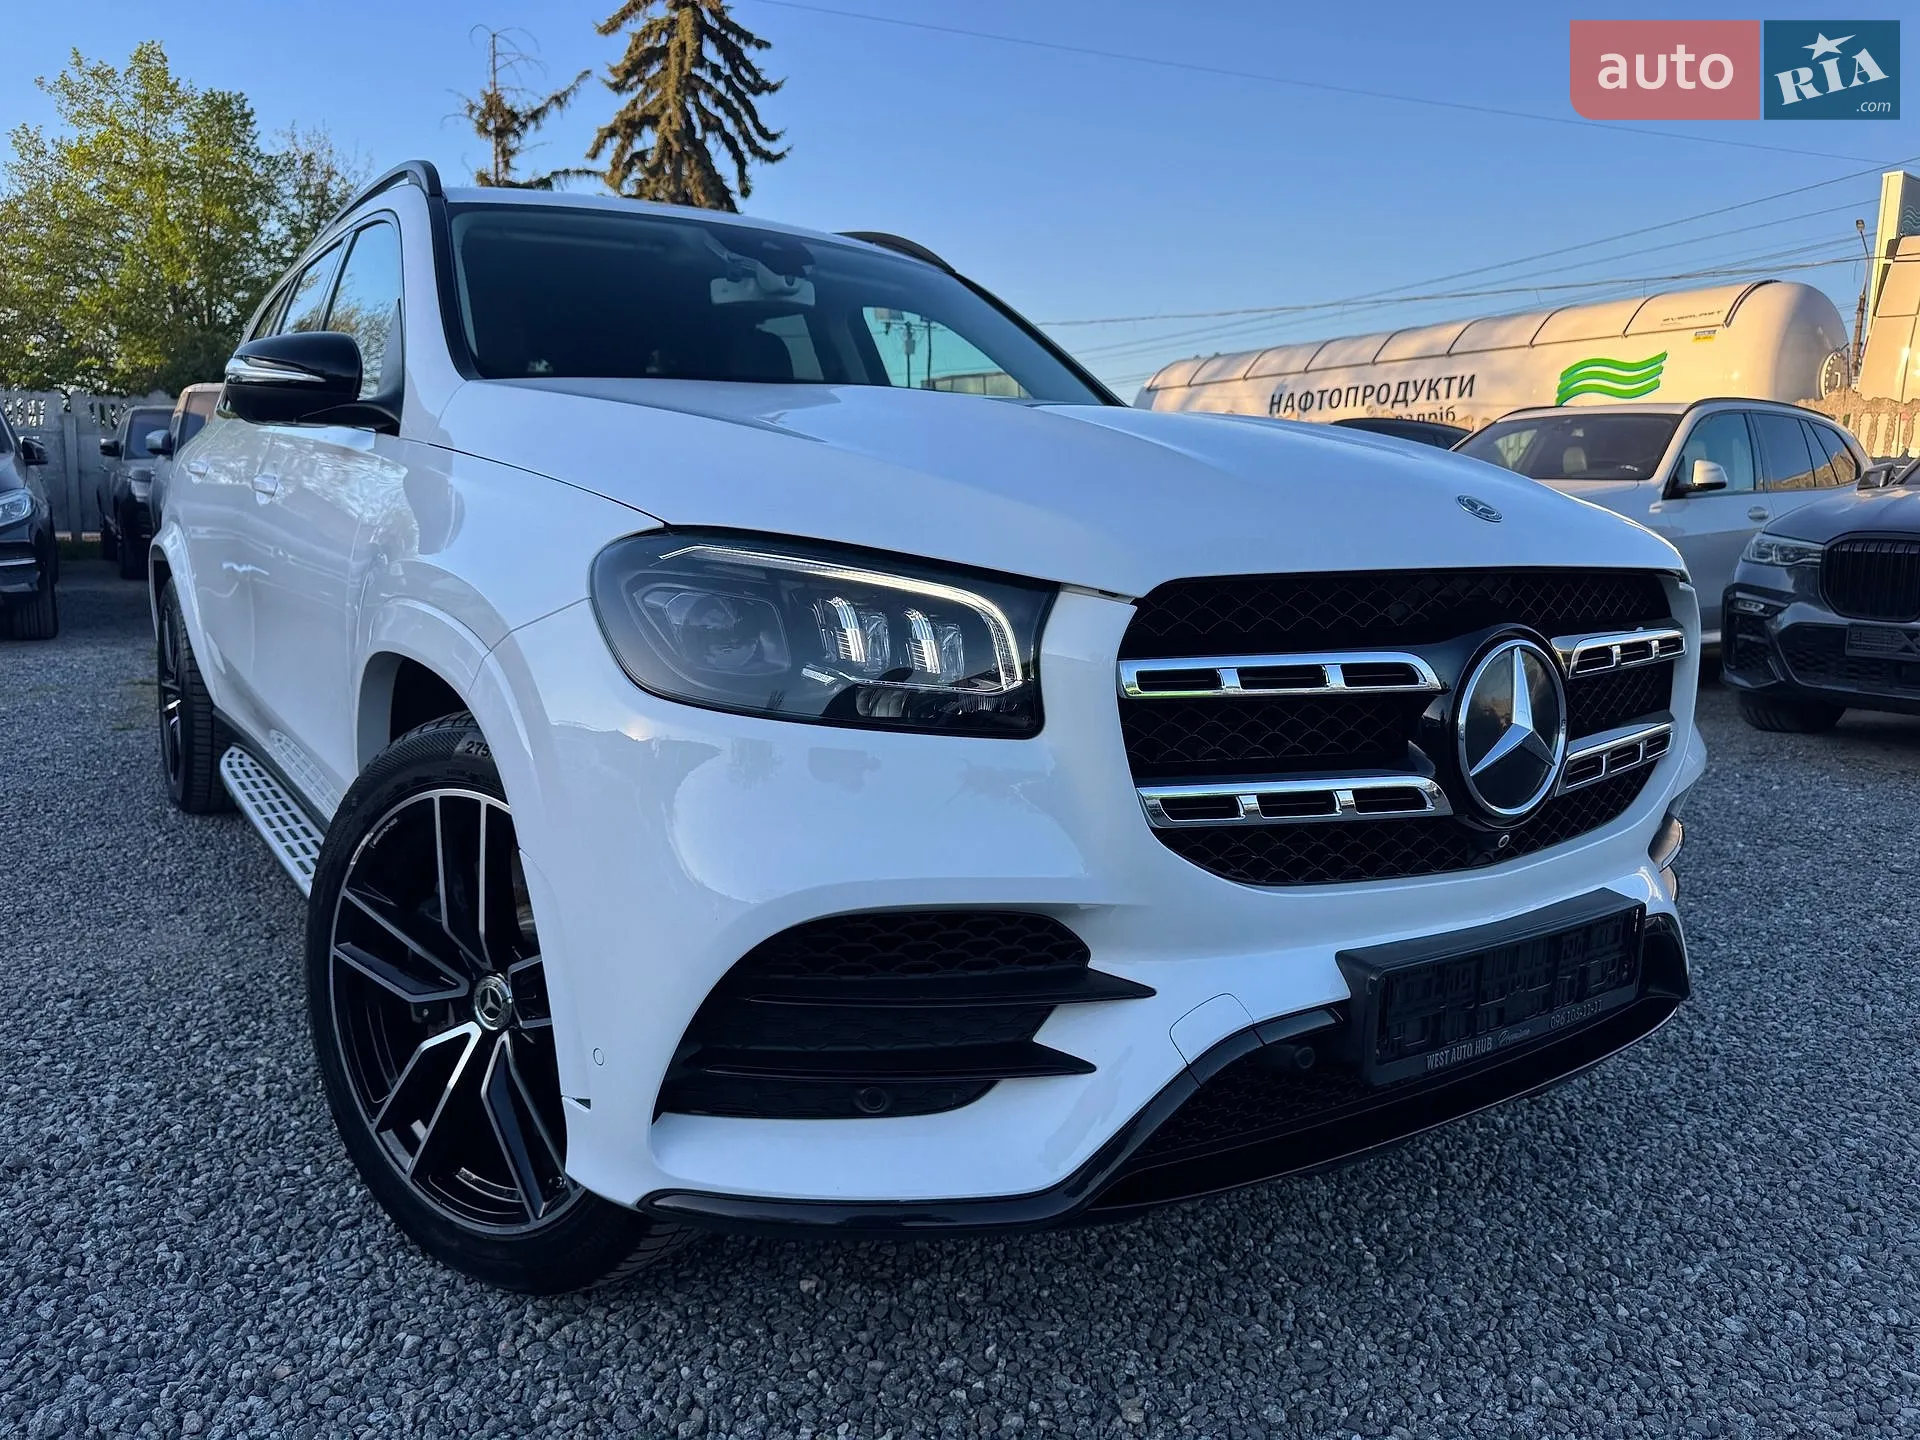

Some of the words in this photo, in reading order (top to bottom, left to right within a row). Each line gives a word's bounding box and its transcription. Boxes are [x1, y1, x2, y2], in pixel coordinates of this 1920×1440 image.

[1268, 374, 1476, 415] НАФТОПРОДУКТИ
[1426, 1049, 1450, 1071] WEST
[1450, 1042, 1473, 1064] AUTO
[1475, 1036, 1493, 1057] HUB
